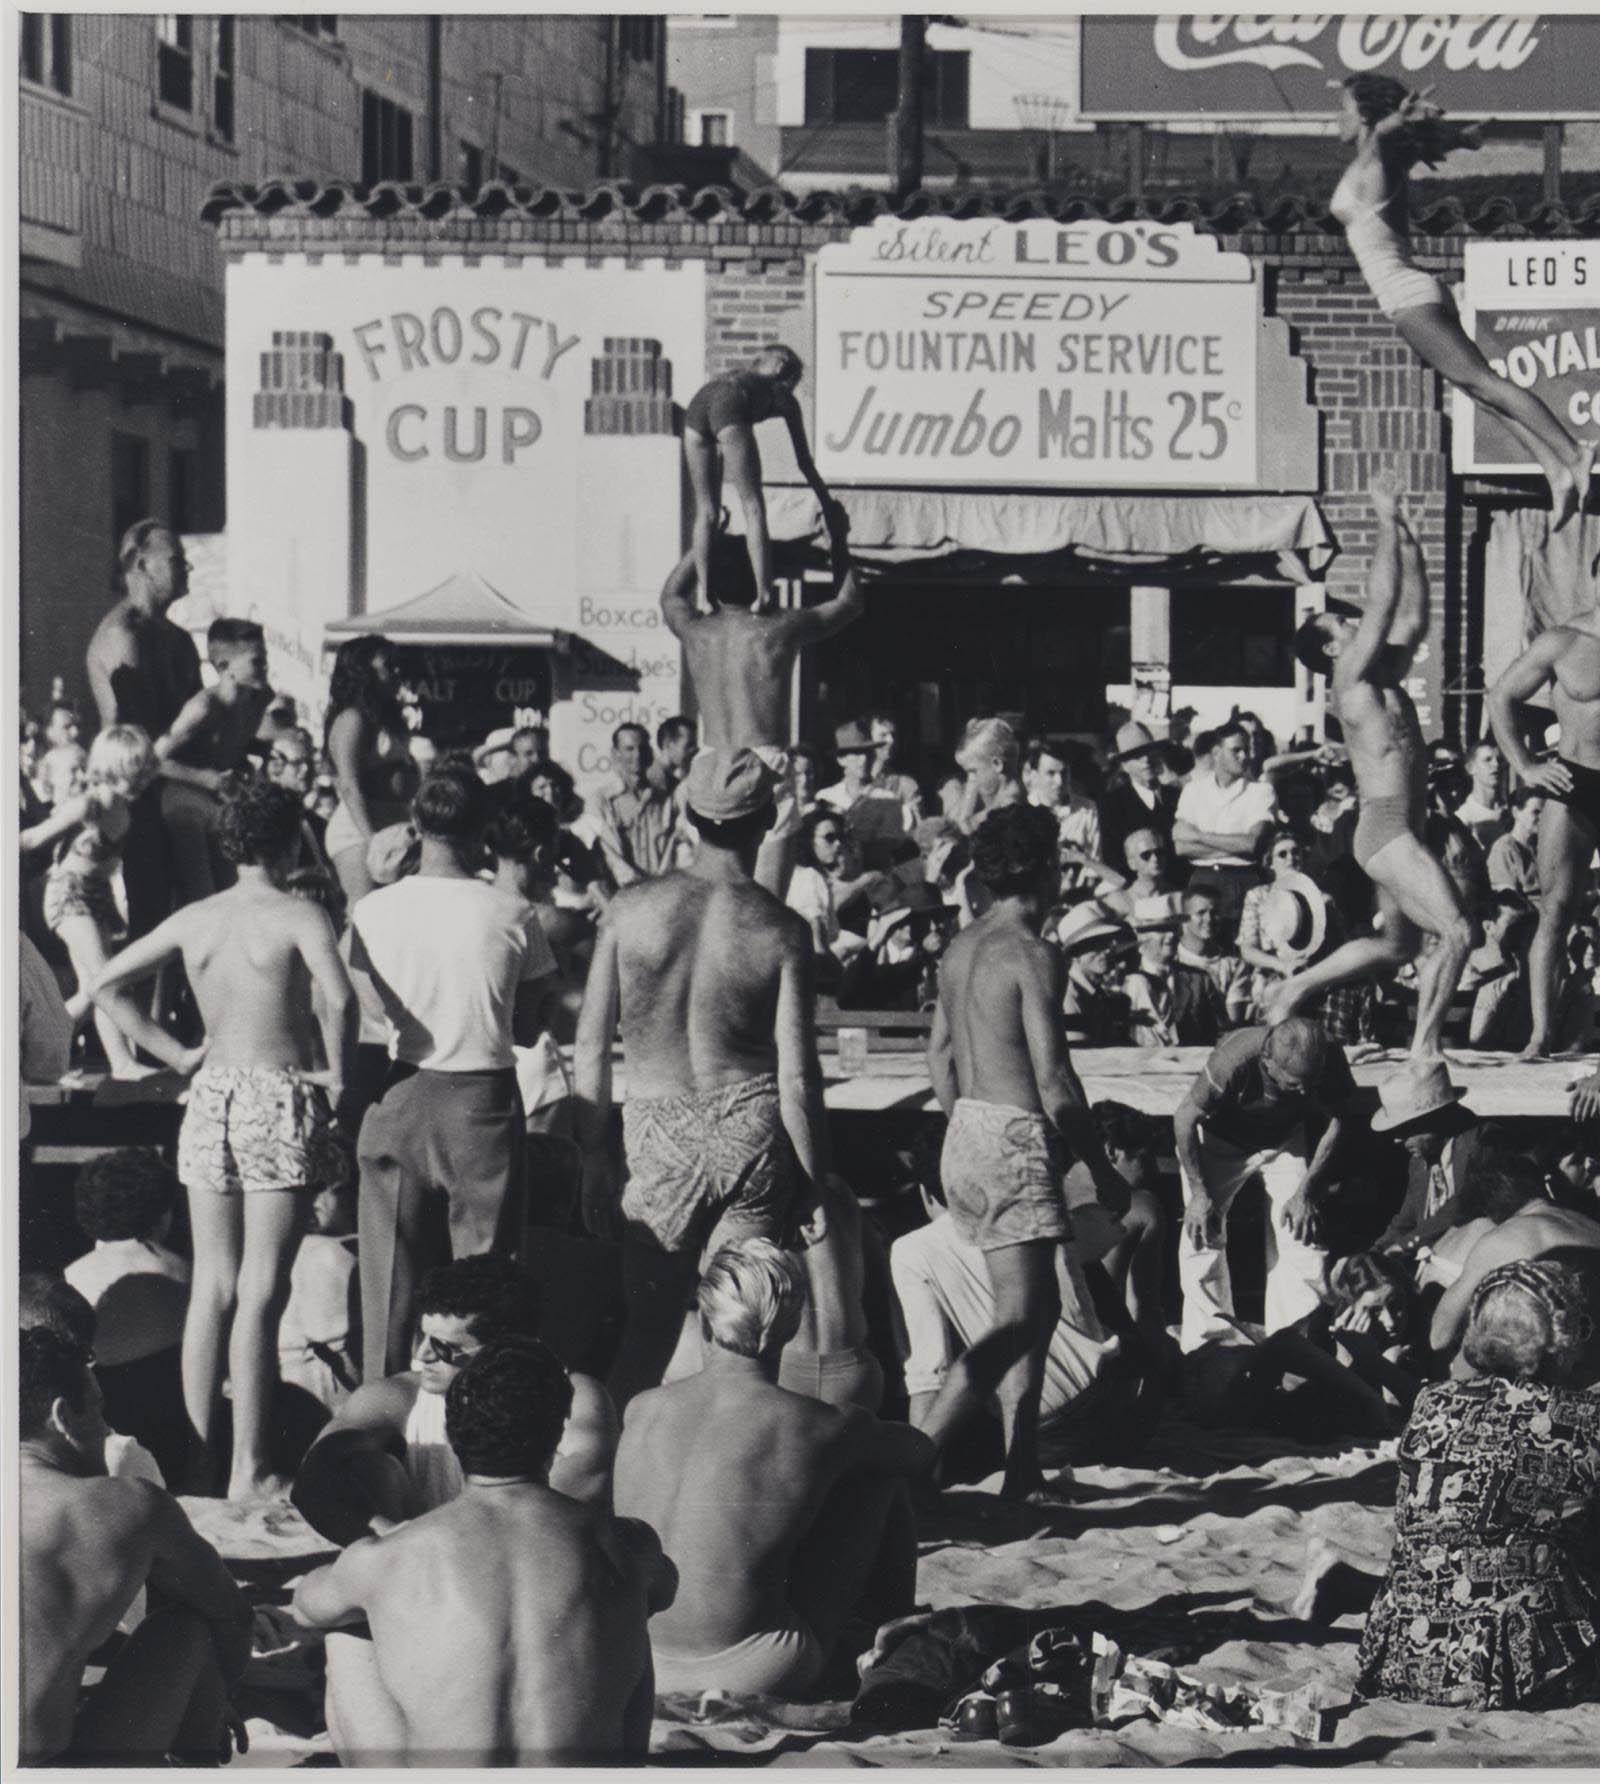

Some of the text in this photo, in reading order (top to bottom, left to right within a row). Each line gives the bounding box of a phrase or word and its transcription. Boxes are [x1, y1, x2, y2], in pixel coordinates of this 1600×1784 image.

[872, 227, 1180, 268] Silent LEO'S
[1508, 251, 1587, 287] LEO'S
[922, 291, 1130, 321] SPEEDY
[1494, 317, 1552, 331] DRINK
[353, 306, 581, 381] FROSTY
[839, 331, 1225, 376] FOUNTAIN SERVICE
[385, 404, 542, 464] CUP
[825, 385, 1022, 458] Jumbo
[1038, 387, 1154, 459] Malts
[579, 599, 660, 628] Boxca
[495, 679, 536, 702] CUP
